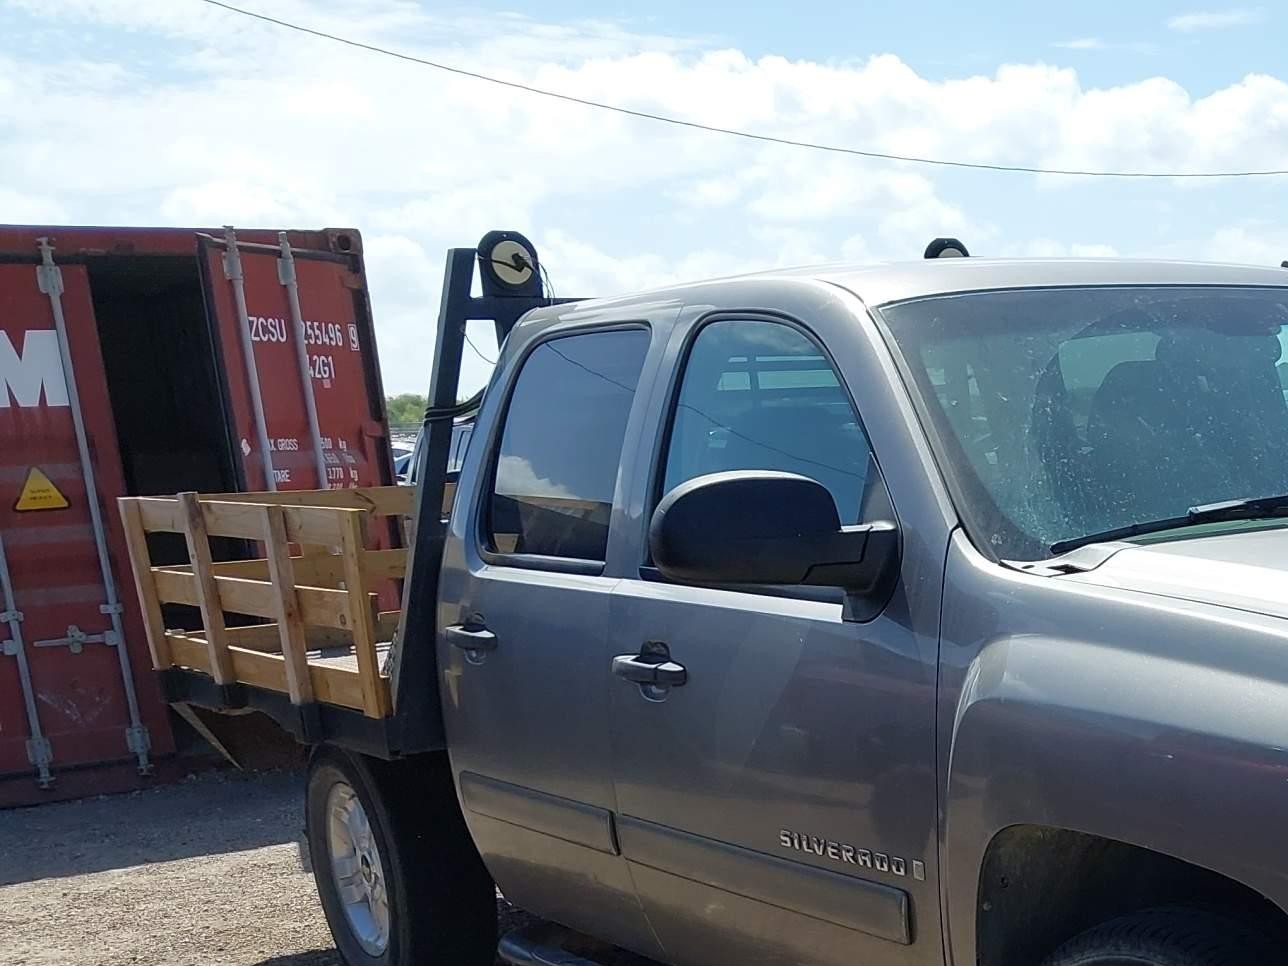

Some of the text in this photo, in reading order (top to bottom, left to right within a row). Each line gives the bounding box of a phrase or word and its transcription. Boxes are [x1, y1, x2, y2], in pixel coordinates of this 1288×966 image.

[248, 316, 287, 343] ZCSU
[0, 329, 70, 408] M
[779, 829, 906, 877] SILVERADO
